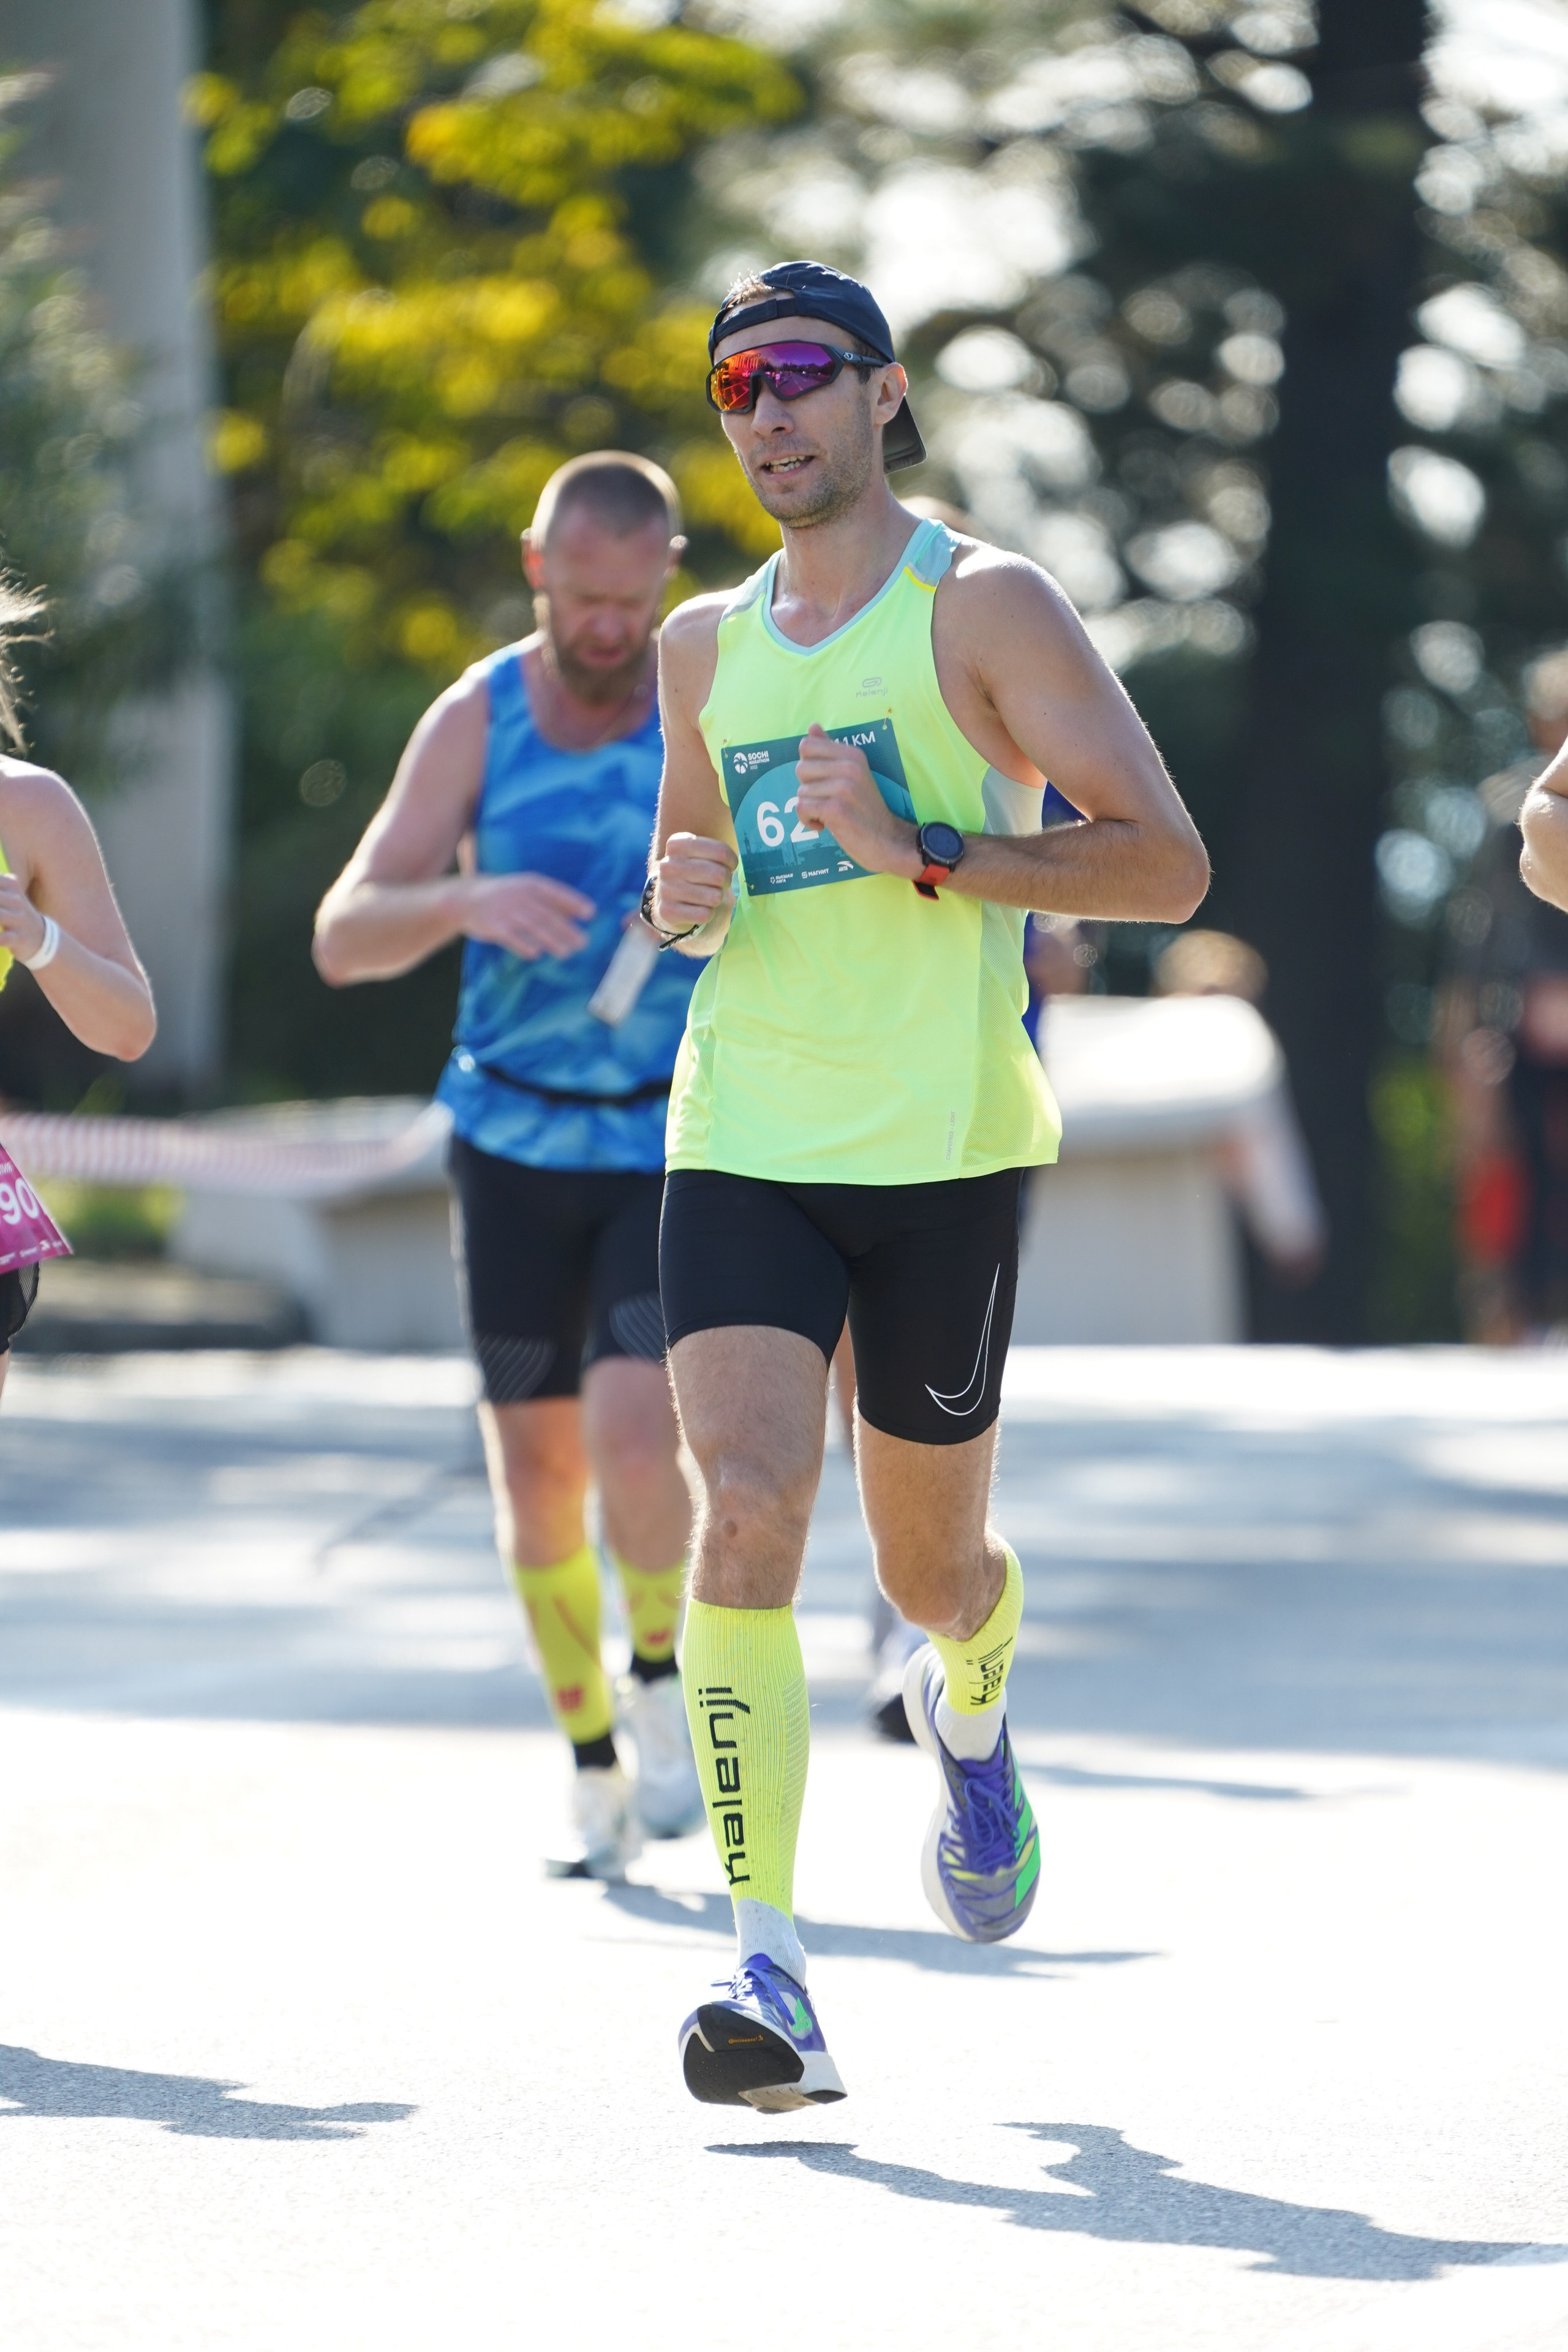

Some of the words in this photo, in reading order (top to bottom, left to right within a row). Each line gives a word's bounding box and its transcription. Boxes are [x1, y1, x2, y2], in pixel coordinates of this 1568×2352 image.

[851, 731, 876, 747] KM
[747, 750, 769, 761] SOCHI
[757, 796, 820, 847] 62
[808, 868, 829, 877] МАГНИТ
